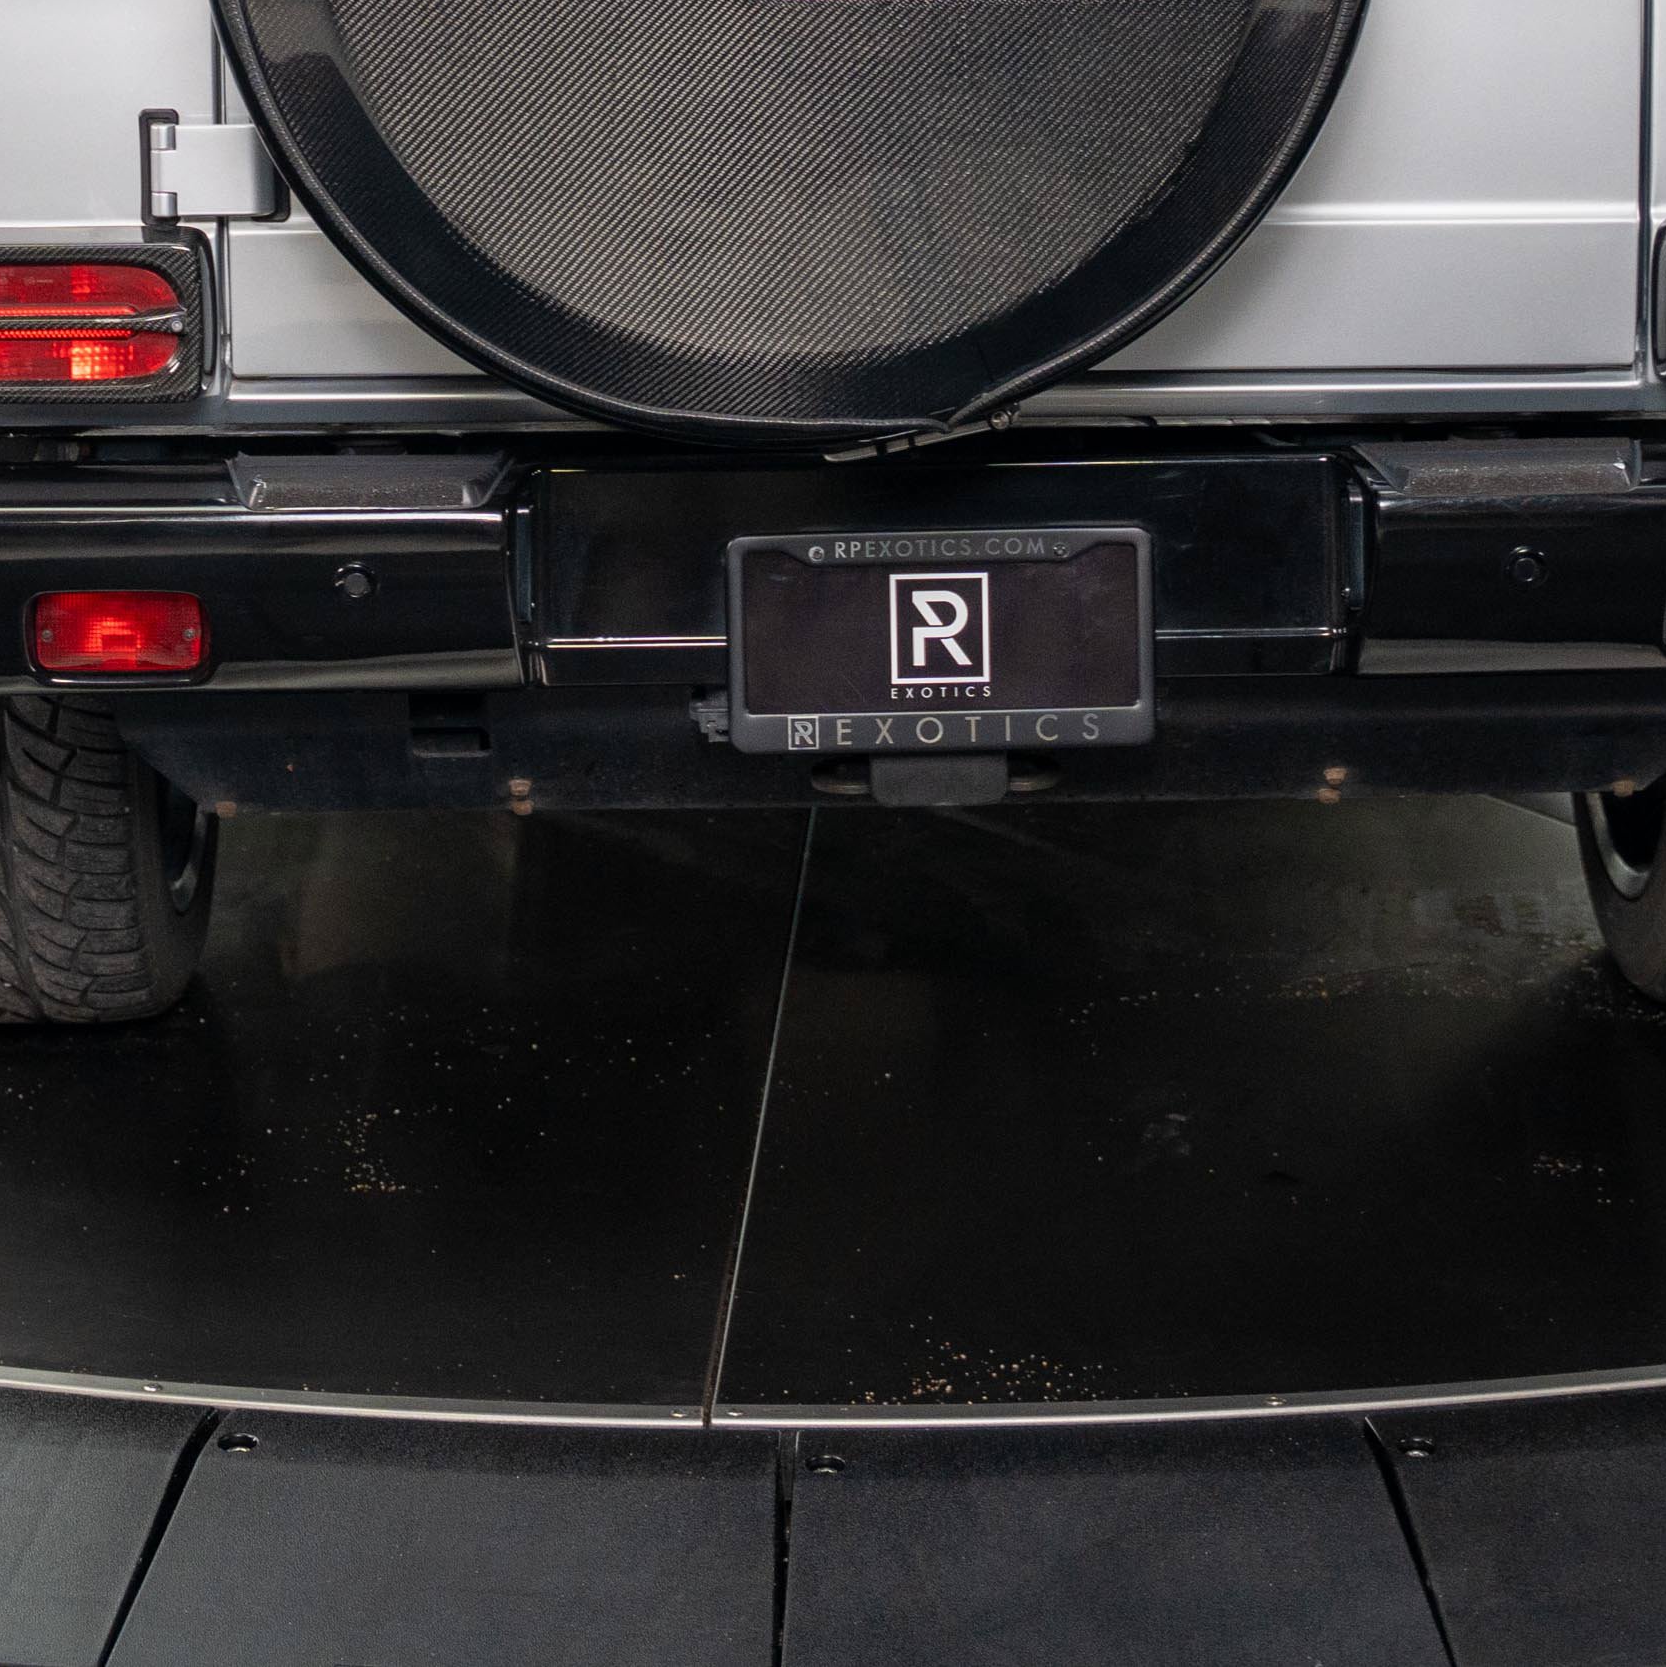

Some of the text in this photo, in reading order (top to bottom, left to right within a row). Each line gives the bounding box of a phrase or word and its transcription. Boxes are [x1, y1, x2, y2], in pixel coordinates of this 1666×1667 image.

[834, 537, 1045, 559] RPEXOTICS.COM
[890, 685, 992, 700] EXOTICS
[836, 712, 1100, 746] EXOTICS
